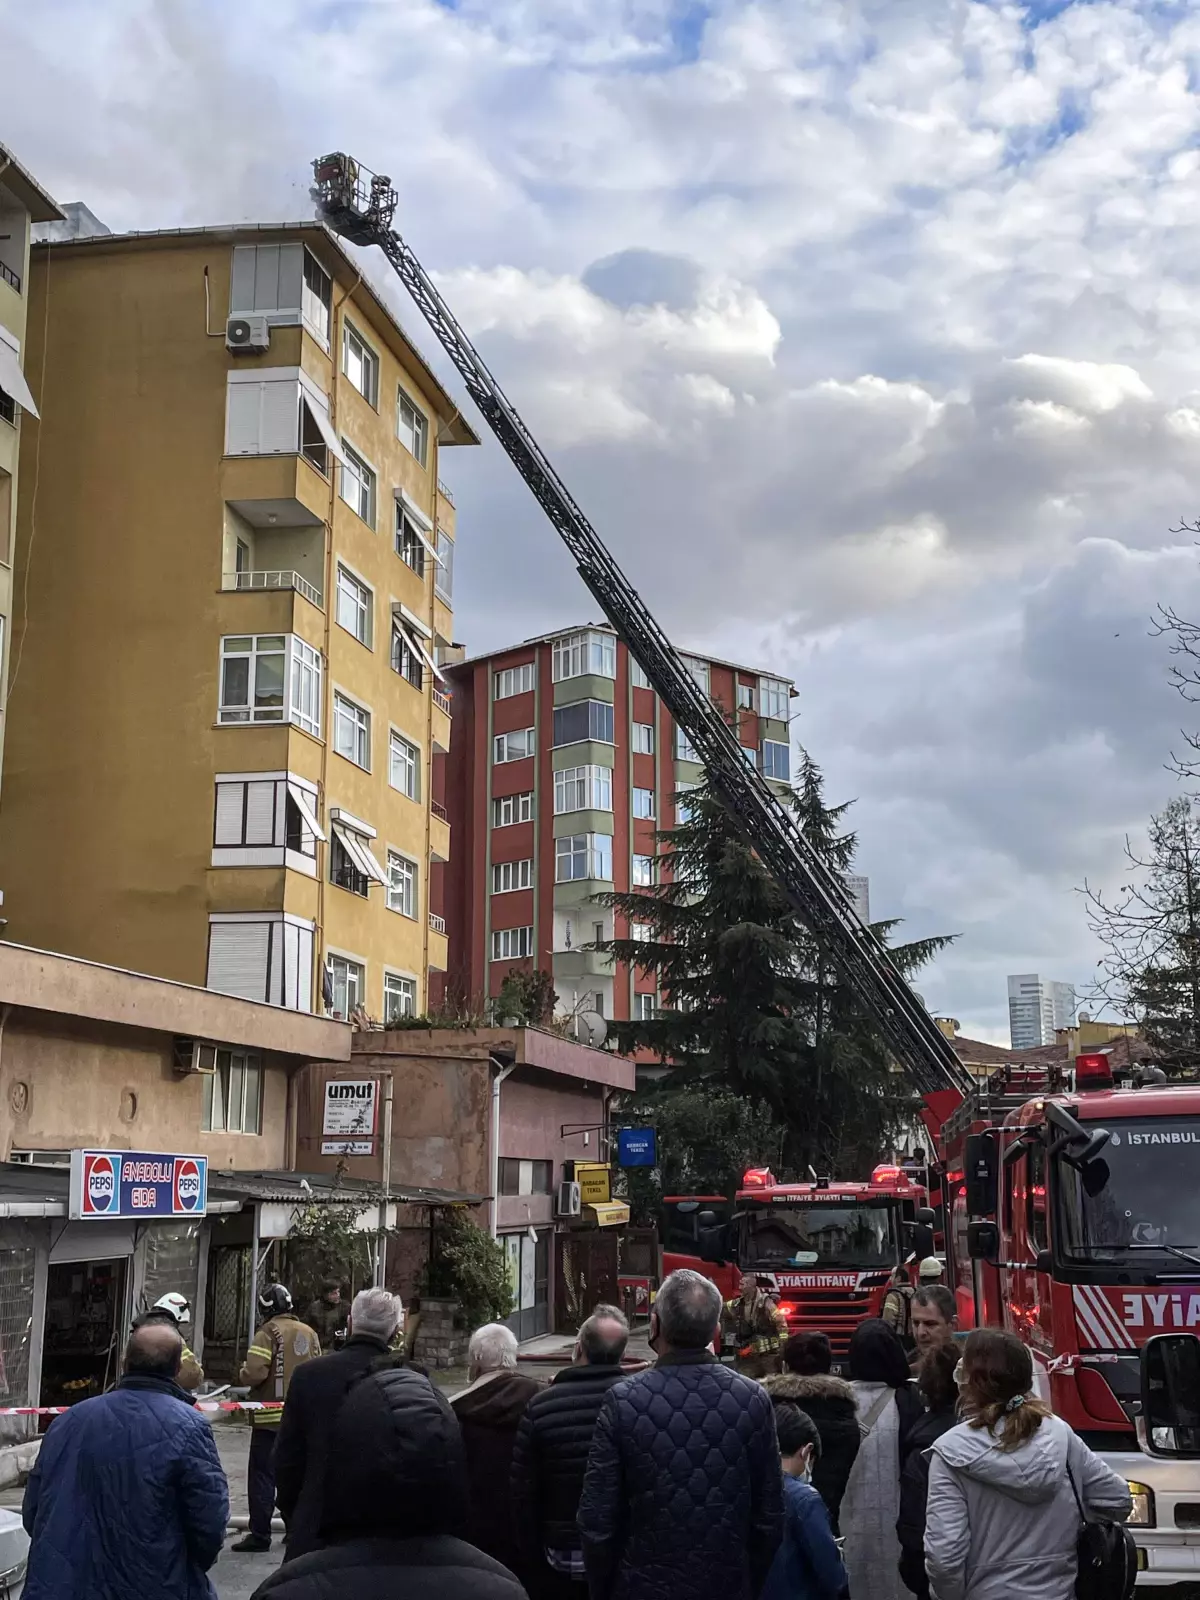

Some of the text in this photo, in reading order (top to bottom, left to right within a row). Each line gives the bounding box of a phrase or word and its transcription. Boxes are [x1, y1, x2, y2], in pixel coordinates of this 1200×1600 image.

[328, 1082, 372, 1098] umut
[1127, 1132, 1200, 1145] İSTANBUL
[122, 1161, 172, 1183] ANADOLU
[90, 1176, 113, 1190] PEPSI
[179, 1178, 199, 1191] PEPSI
[131, 1187, 157, 1207] GIDA
